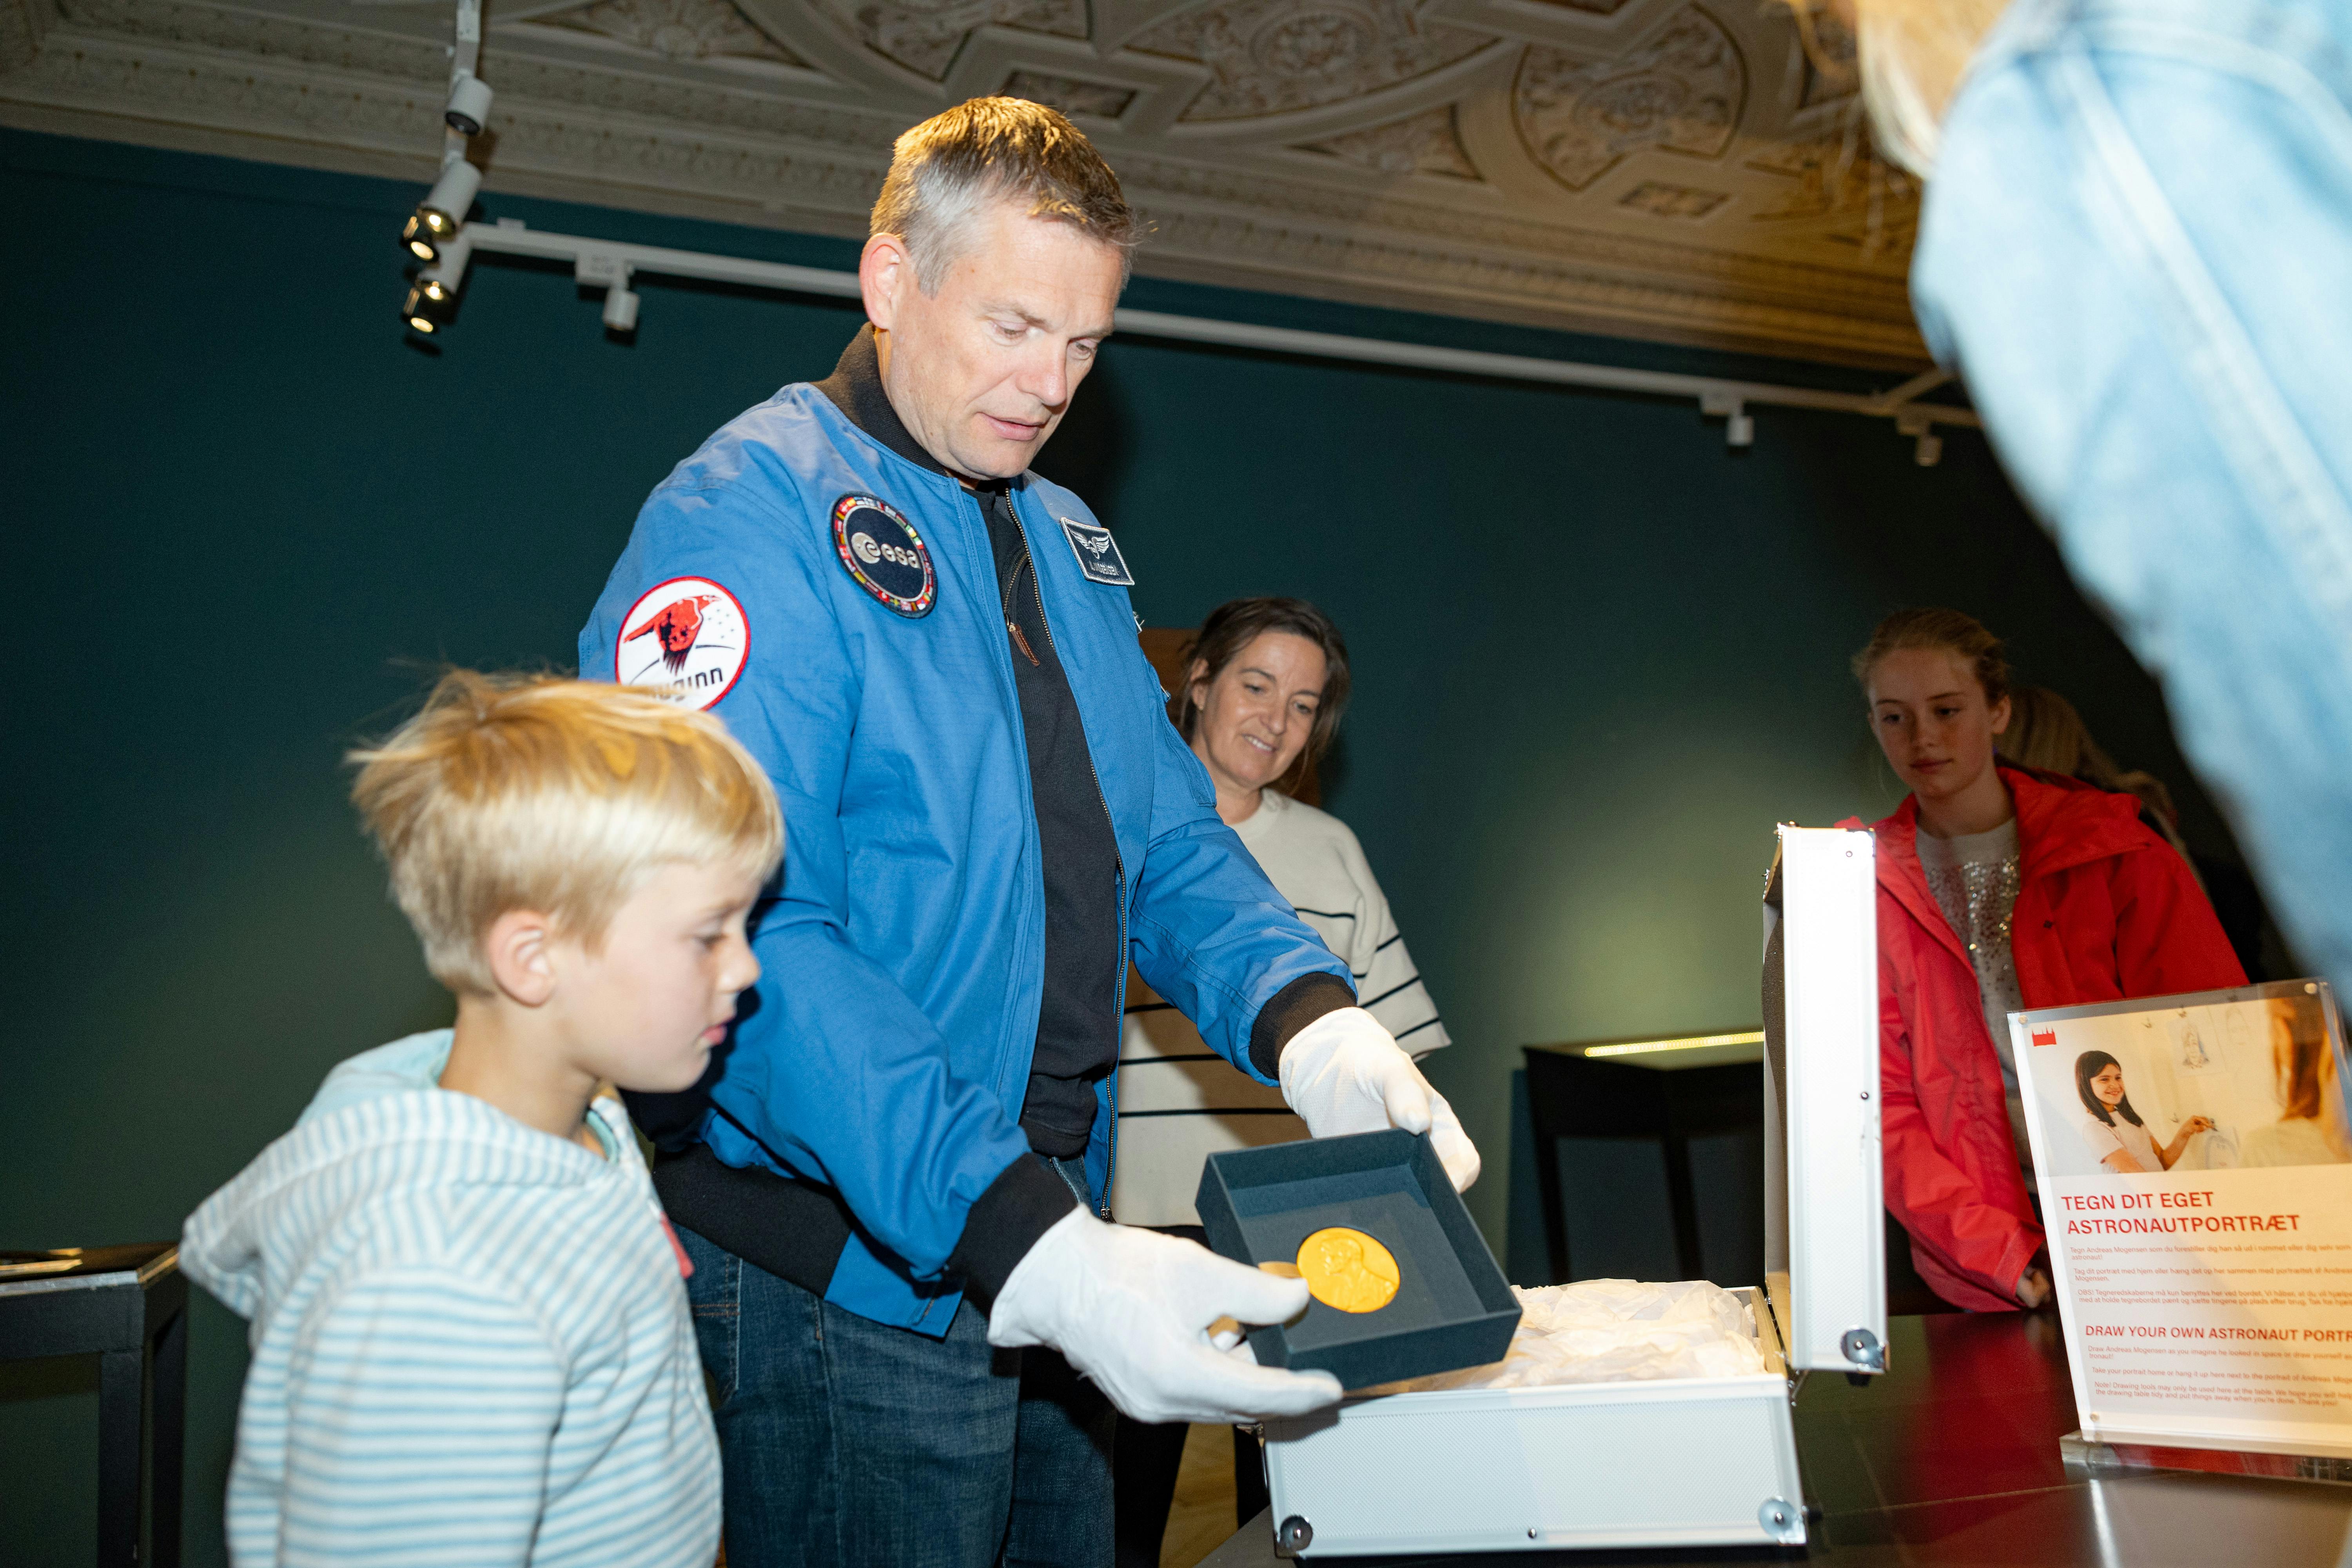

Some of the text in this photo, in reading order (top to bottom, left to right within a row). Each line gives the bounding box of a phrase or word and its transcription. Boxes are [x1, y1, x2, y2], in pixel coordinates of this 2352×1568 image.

[881, 543, 921, 569] esa
[2061, 1192, 2214, 1210] TEGN DIT EGET
[2067, 1214, 2299, 1234] ASTRONAUTPORTRÆT
[2085, 1325, 2125, 1336] DRAW
[2128, 1326, 2166, 1337] YOUR
[2171, 1327, 2204, 1338] OWN
[2209, 1327, 2298, 1341] ASTRONAUT
[2107, 1389, 2132, 1397] drawing
